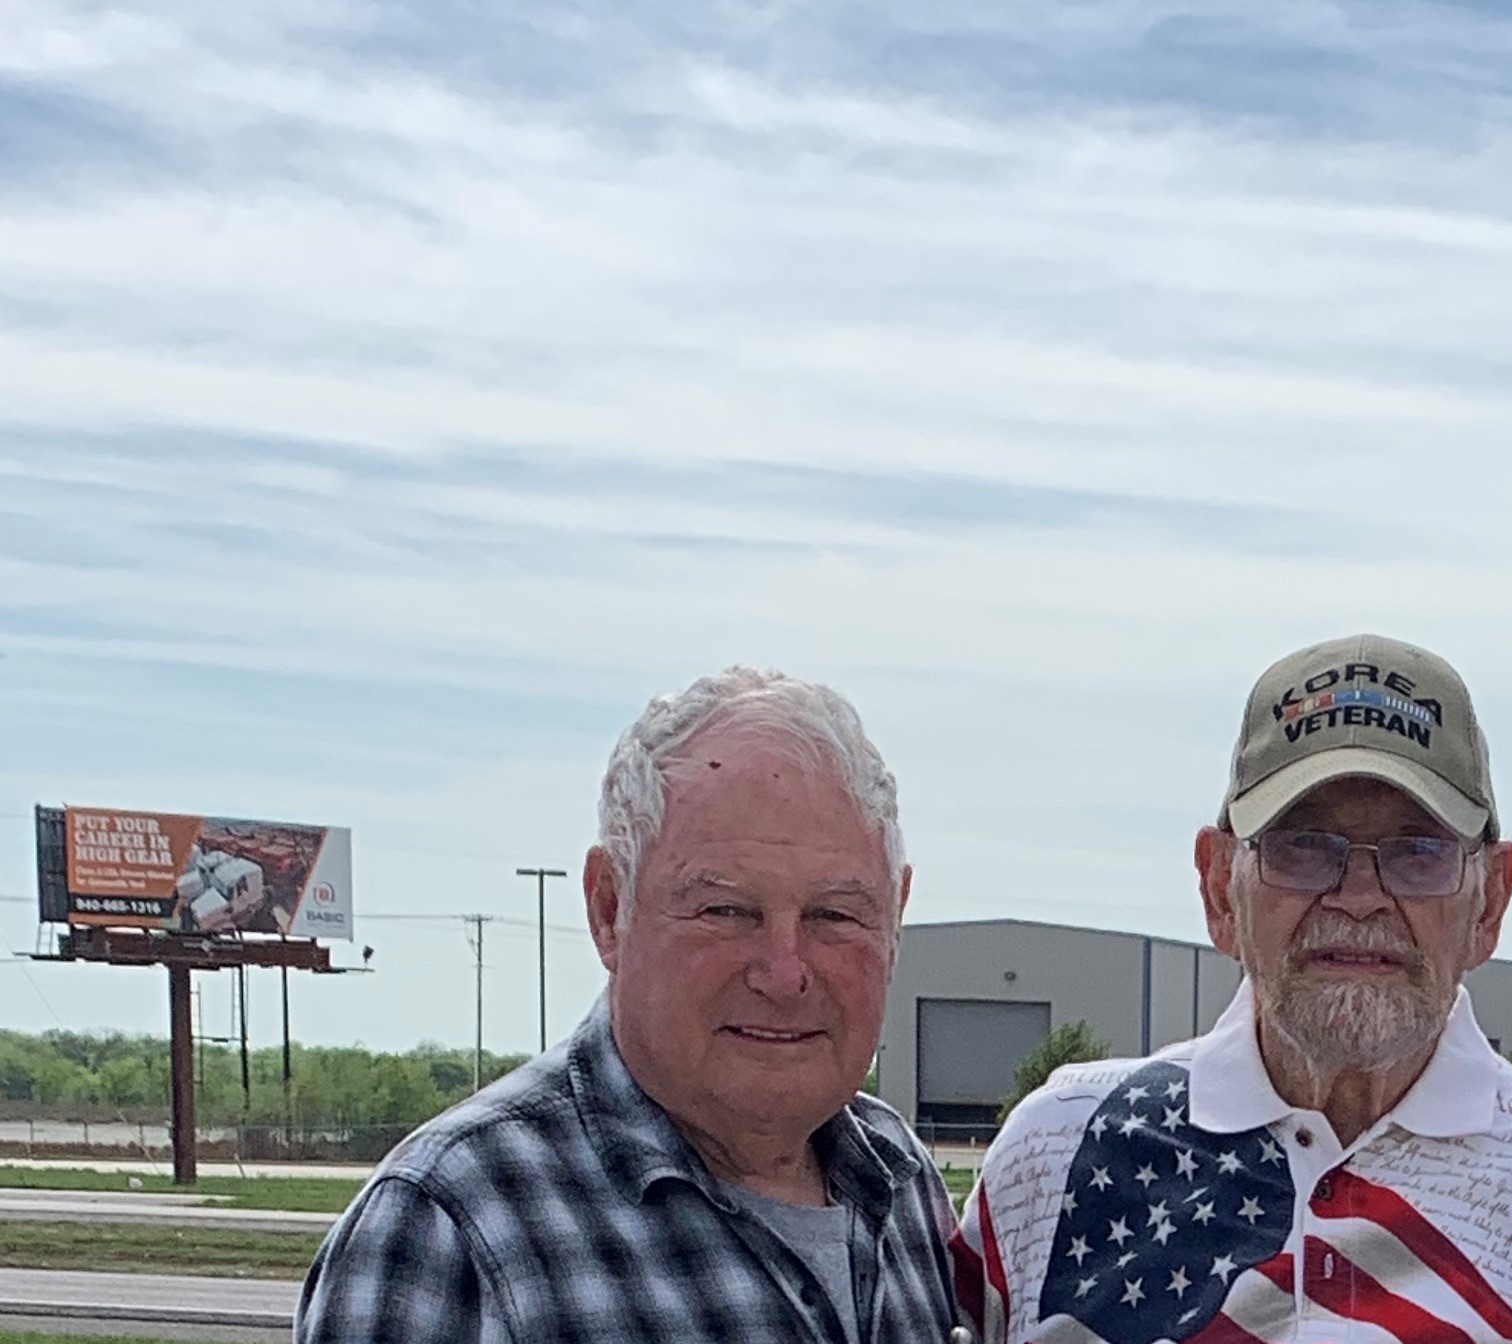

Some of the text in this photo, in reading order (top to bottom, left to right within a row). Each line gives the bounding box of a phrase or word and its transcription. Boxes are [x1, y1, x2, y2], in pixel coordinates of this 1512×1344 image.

[1272, 662, 1444, 727] KOREA
[1284, 705, 1431, 750] VETERAN
[74, 813, 160, 833] PUT YOUR
[74, 829, 170, 850] CAREER IN
[75, 845, 174, 866] HIGH GEAR
